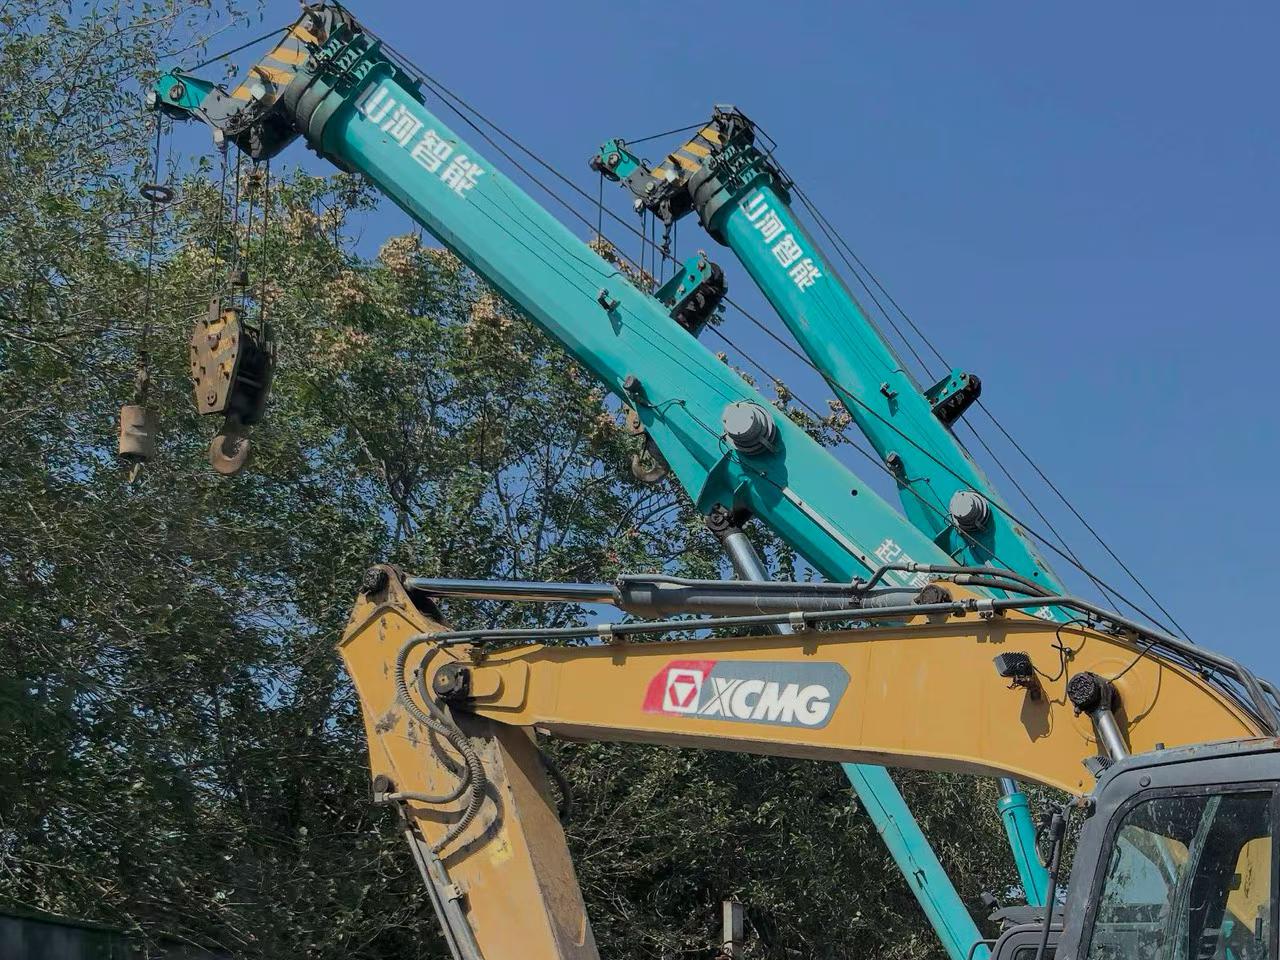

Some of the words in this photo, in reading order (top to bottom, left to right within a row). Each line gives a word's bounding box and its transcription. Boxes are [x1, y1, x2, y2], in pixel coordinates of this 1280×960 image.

[354, 82, 485, 199] 山河智能
[738, 188, 822, 293] 山河智能
[698, 677, 831, 726] XCMG
